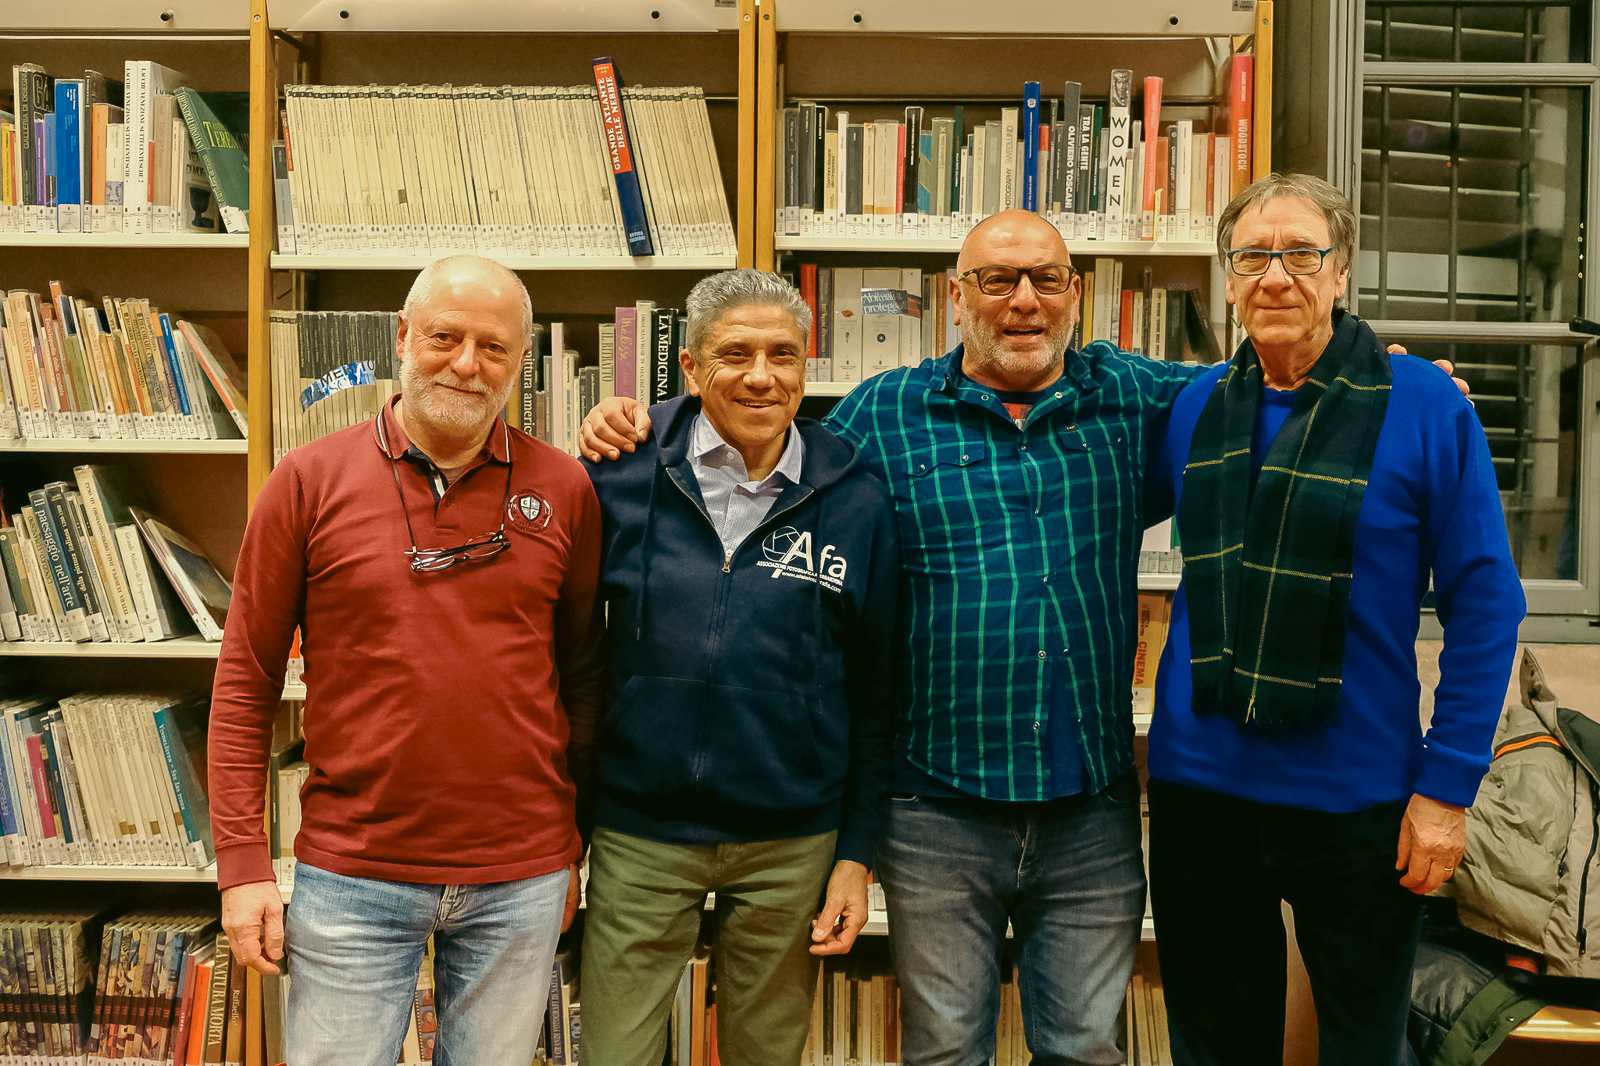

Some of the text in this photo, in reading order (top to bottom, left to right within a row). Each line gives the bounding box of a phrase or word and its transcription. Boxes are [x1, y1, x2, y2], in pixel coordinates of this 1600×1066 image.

[598, 78, 620, 170] GRANDE ATLANTE
[606, 76, 625, 148] DELLE NEBBIE
[187, 123, 206, 151] ANTONIO
[1080, 146, 1088, 171] GENTE
[1082, 134, 1089, 143] LA
[1238, 118, 1248, 171] WOODSTOCK
[1065, 126, 1075, 208] OLIVIERO TOSCANI
[1110, 116, 1128, 207] WOMEN
[44, 317, 58, 356] Enciclopedia
[56, 373, 65, 396] candele
[618, 317, 634, 360] Matisse
[657, 315, 668, 399] LA MEDICINA
[602, 343, 613, 382] RITRATTO
[84, 482, 93, 496] OGGI
[33, 497, 78, 608] Il paesaggio nell'arte
[63, 528, 75, 552] italiana
[125, 532, 134, 553] Grande
[130, 554, 139, 577] Atlante
[771, 531, 847, 580] Afa
[70, 552, 83, 575] pittura
[76, 575, 87, 592] della
[111, 568, 122, 593] EUROPEA
[81, 593, 94, 616] ronaca
[1135, 641, 1147, 685] CINEMA
[207, 944, 230, 1046] LA NATURA MORTA
[552, 1001, 560, 1032] FOTOGRAFI
